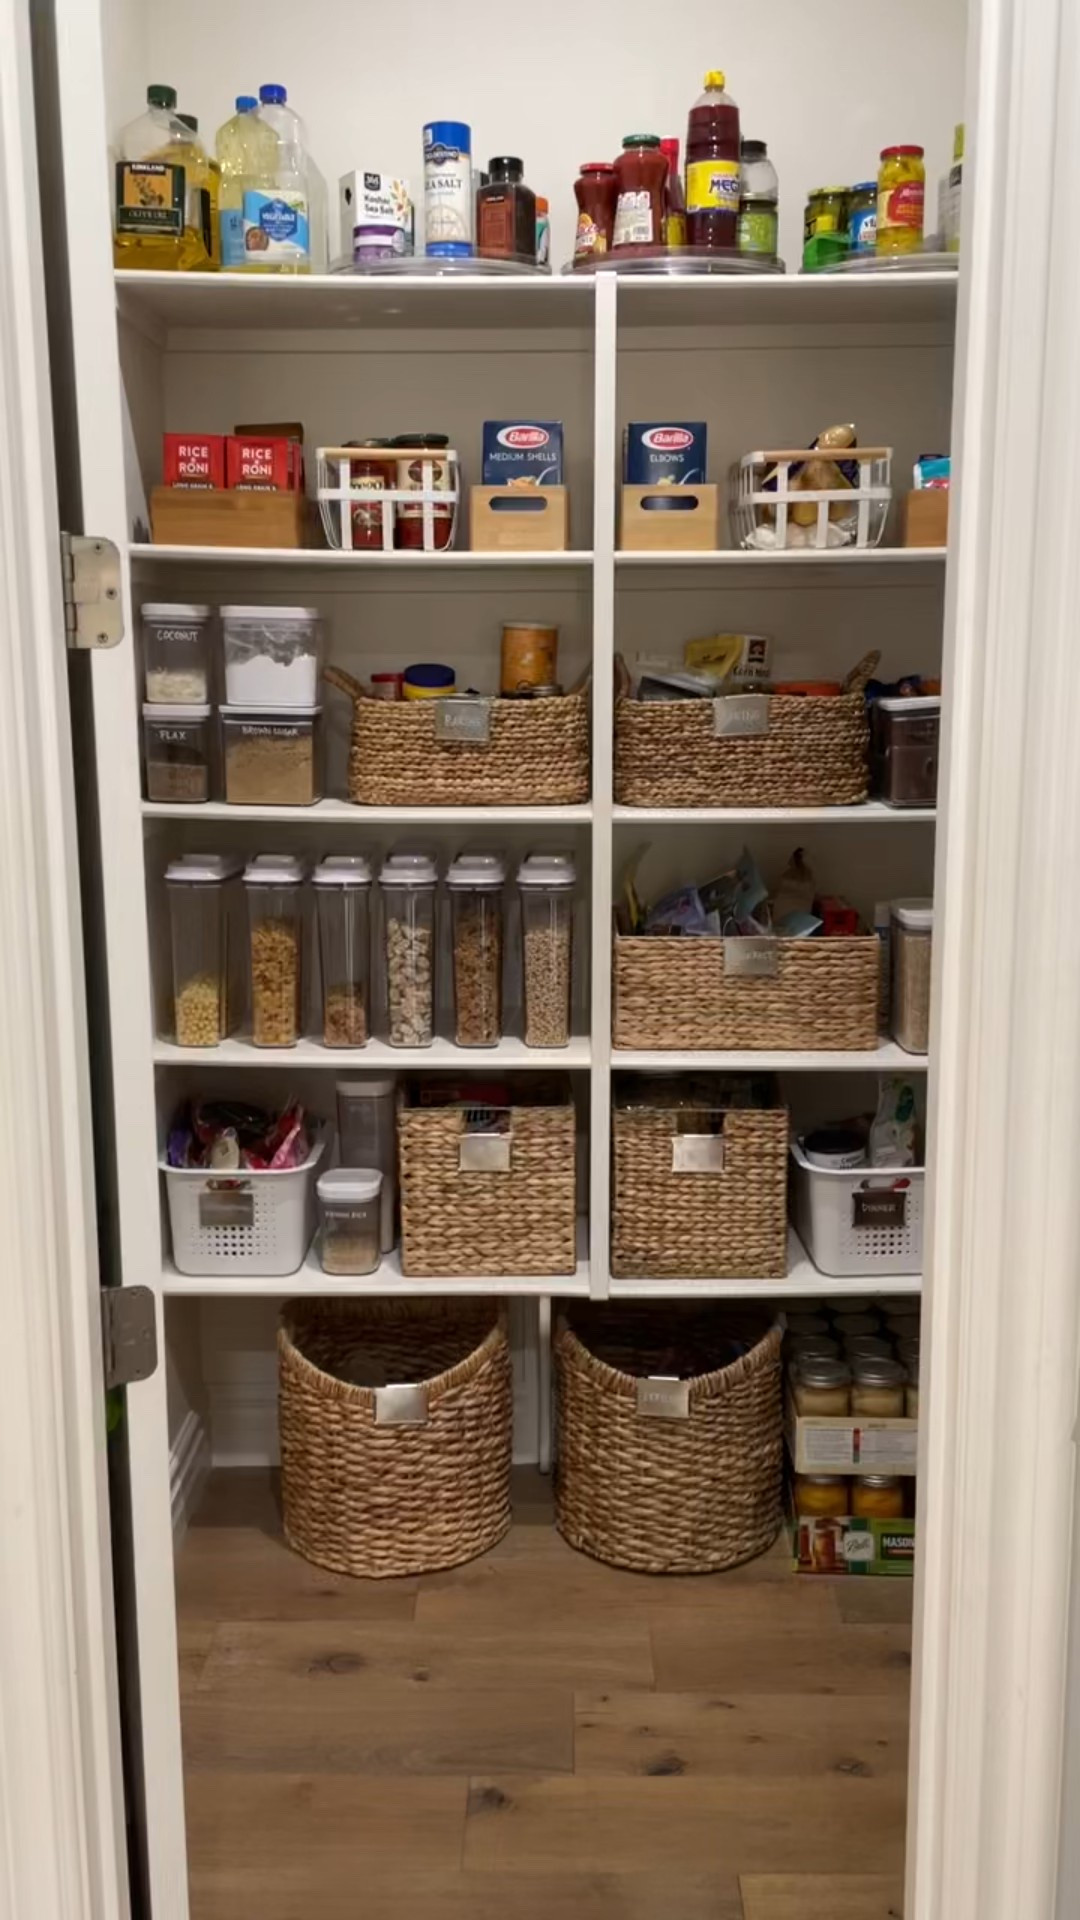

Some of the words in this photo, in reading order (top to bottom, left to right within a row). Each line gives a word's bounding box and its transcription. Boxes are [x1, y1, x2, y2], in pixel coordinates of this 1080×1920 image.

[437, 179, 463, 189] SALT
[507, 431, 546, 444] Barilla
[652, 431, 691, 444] Barilla
[178, 445, 208, 458] RICE
[242, 447, 272, 460] RICE
[488, 452, 524, 462] MEDIUM
[527, 452, 557, 463] SHELLS
[649, 453, 685, 464] ELBOWS
[178, 463, 208, 474] RONI
[242, 464, 272, 476] RONI
[157, 629, 199, 643] COCONUT
[158, 729, 187, 741] FLAX
